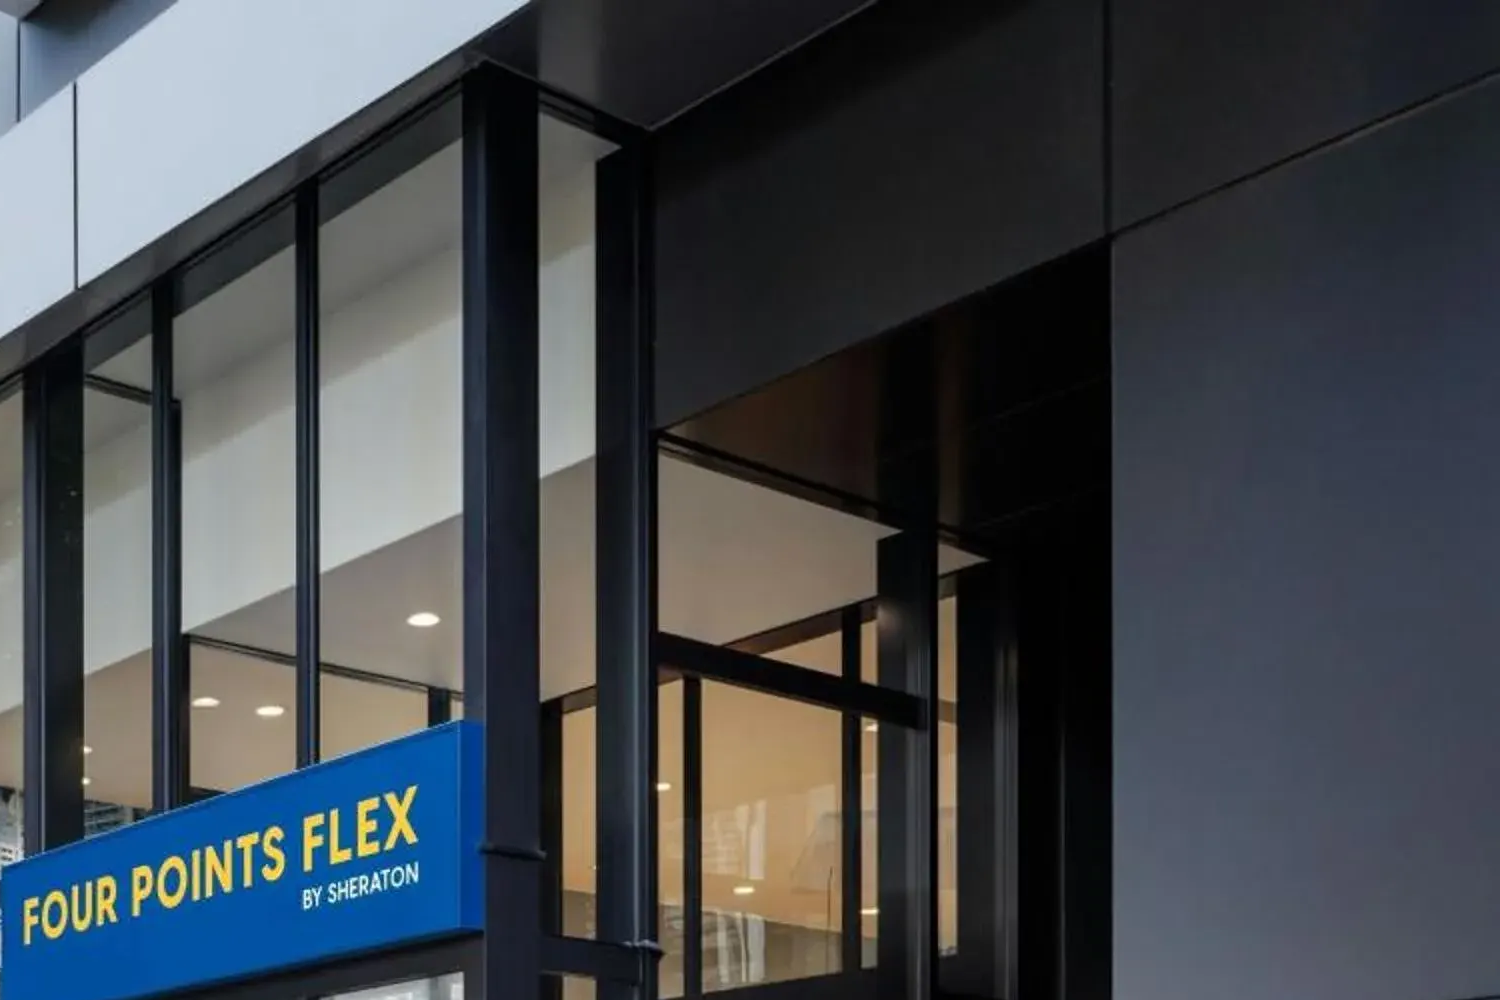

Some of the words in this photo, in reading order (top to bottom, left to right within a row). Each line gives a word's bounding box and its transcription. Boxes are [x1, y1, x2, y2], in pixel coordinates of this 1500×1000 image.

[22, 875, 118, 945] FOUR
[131, 825, 286, 917] POINTS
[302, 785, 419, 872] FLEX
[302, 886, 324, 910] BY
[327, 862, 420, 904] SHERATON
